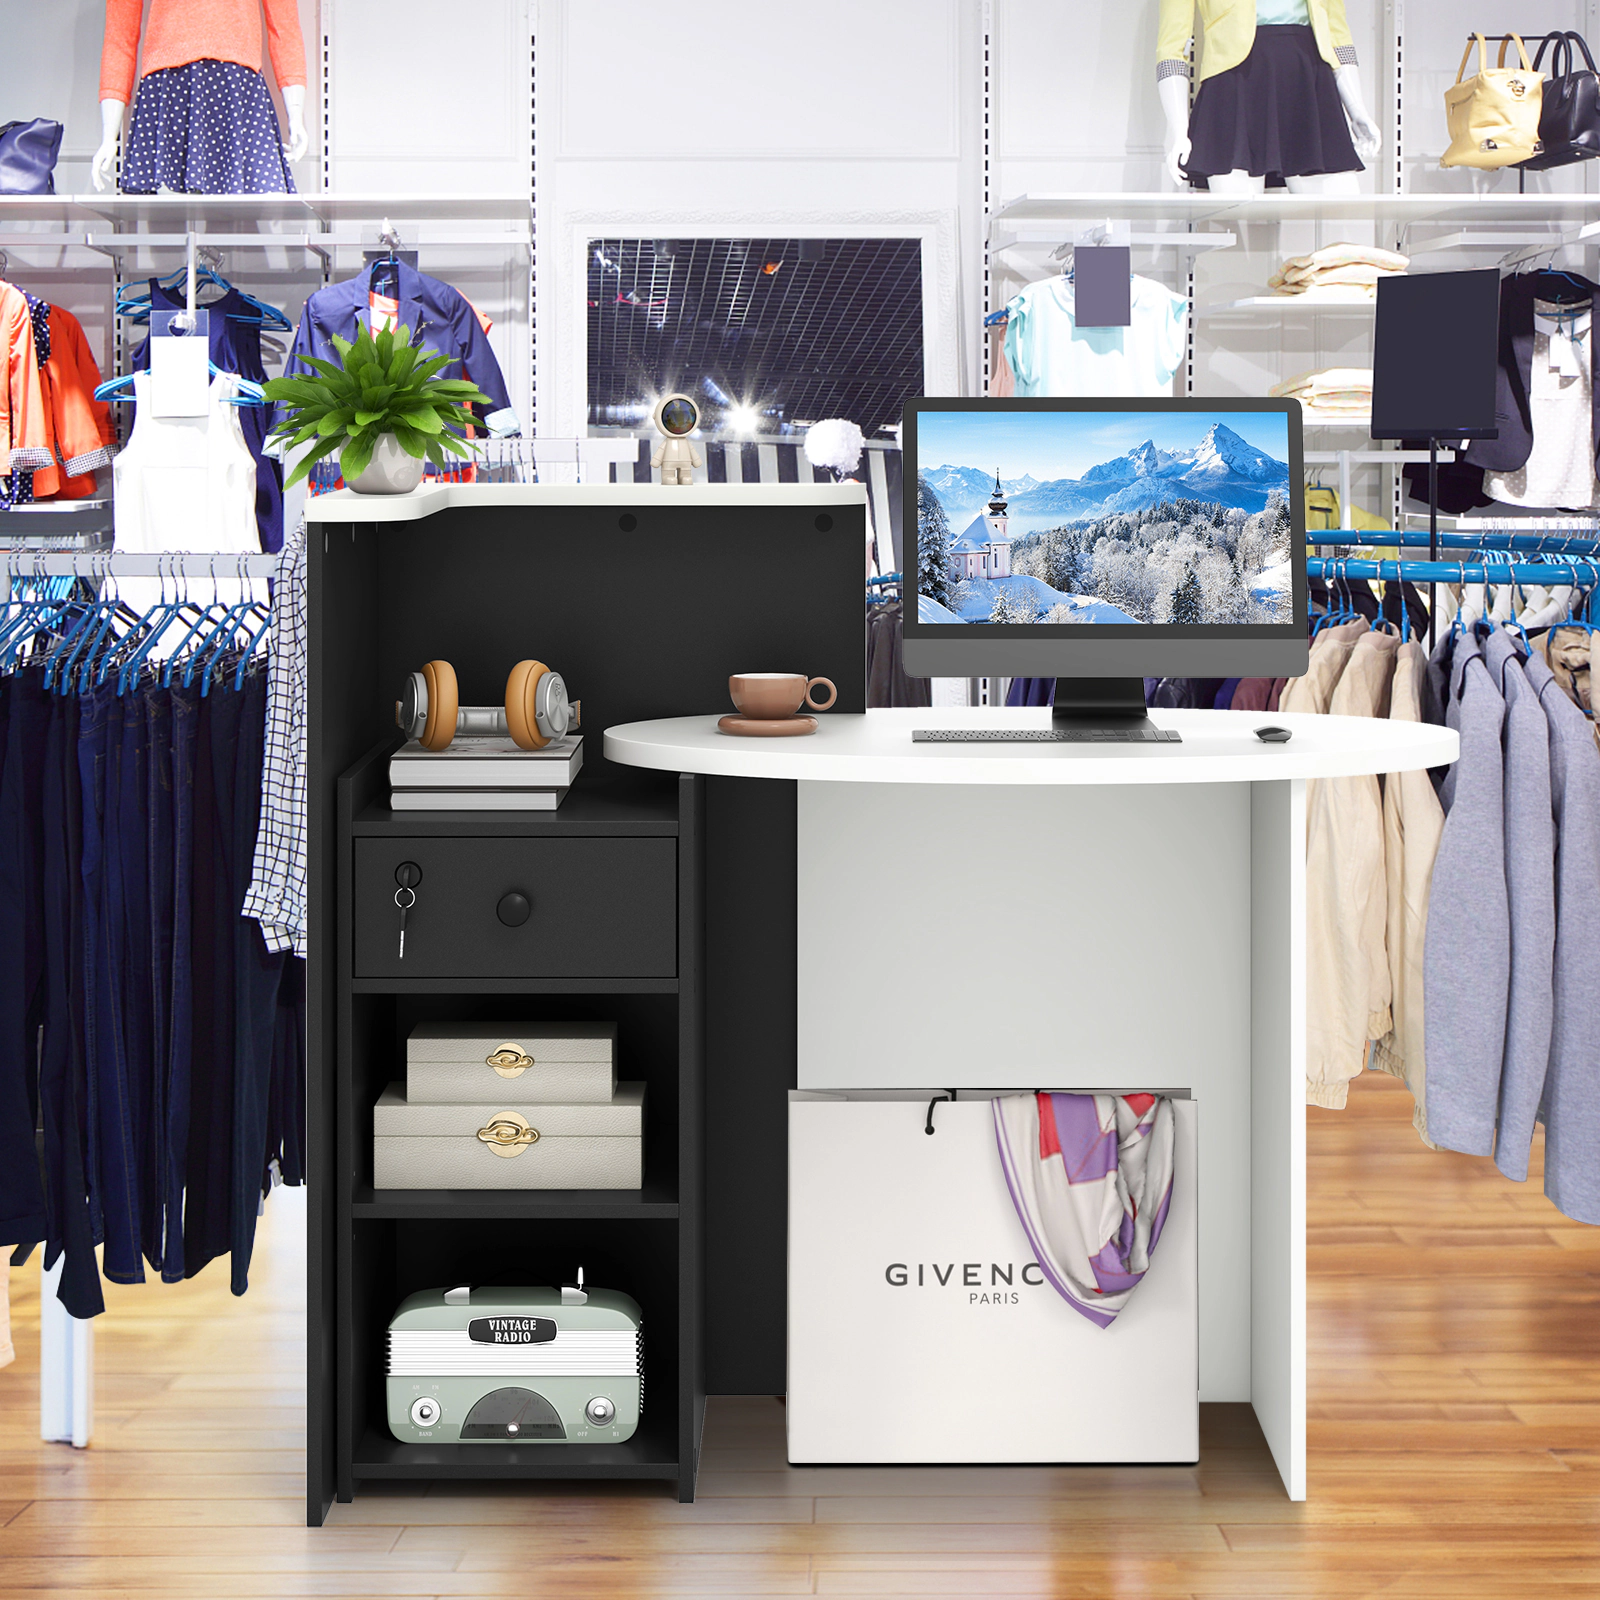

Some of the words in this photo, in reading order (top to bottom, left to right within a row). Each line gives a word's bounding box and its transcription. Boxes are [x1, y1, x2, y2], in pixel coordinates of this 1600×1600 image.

[885, 1263, 1043, 1286] GIVENC
[969, 1292, 1019, 1304] PARIS
[488, 1319, 537, 1331] VINTAGE
[494, 1331, 531, 1343] RADIO
